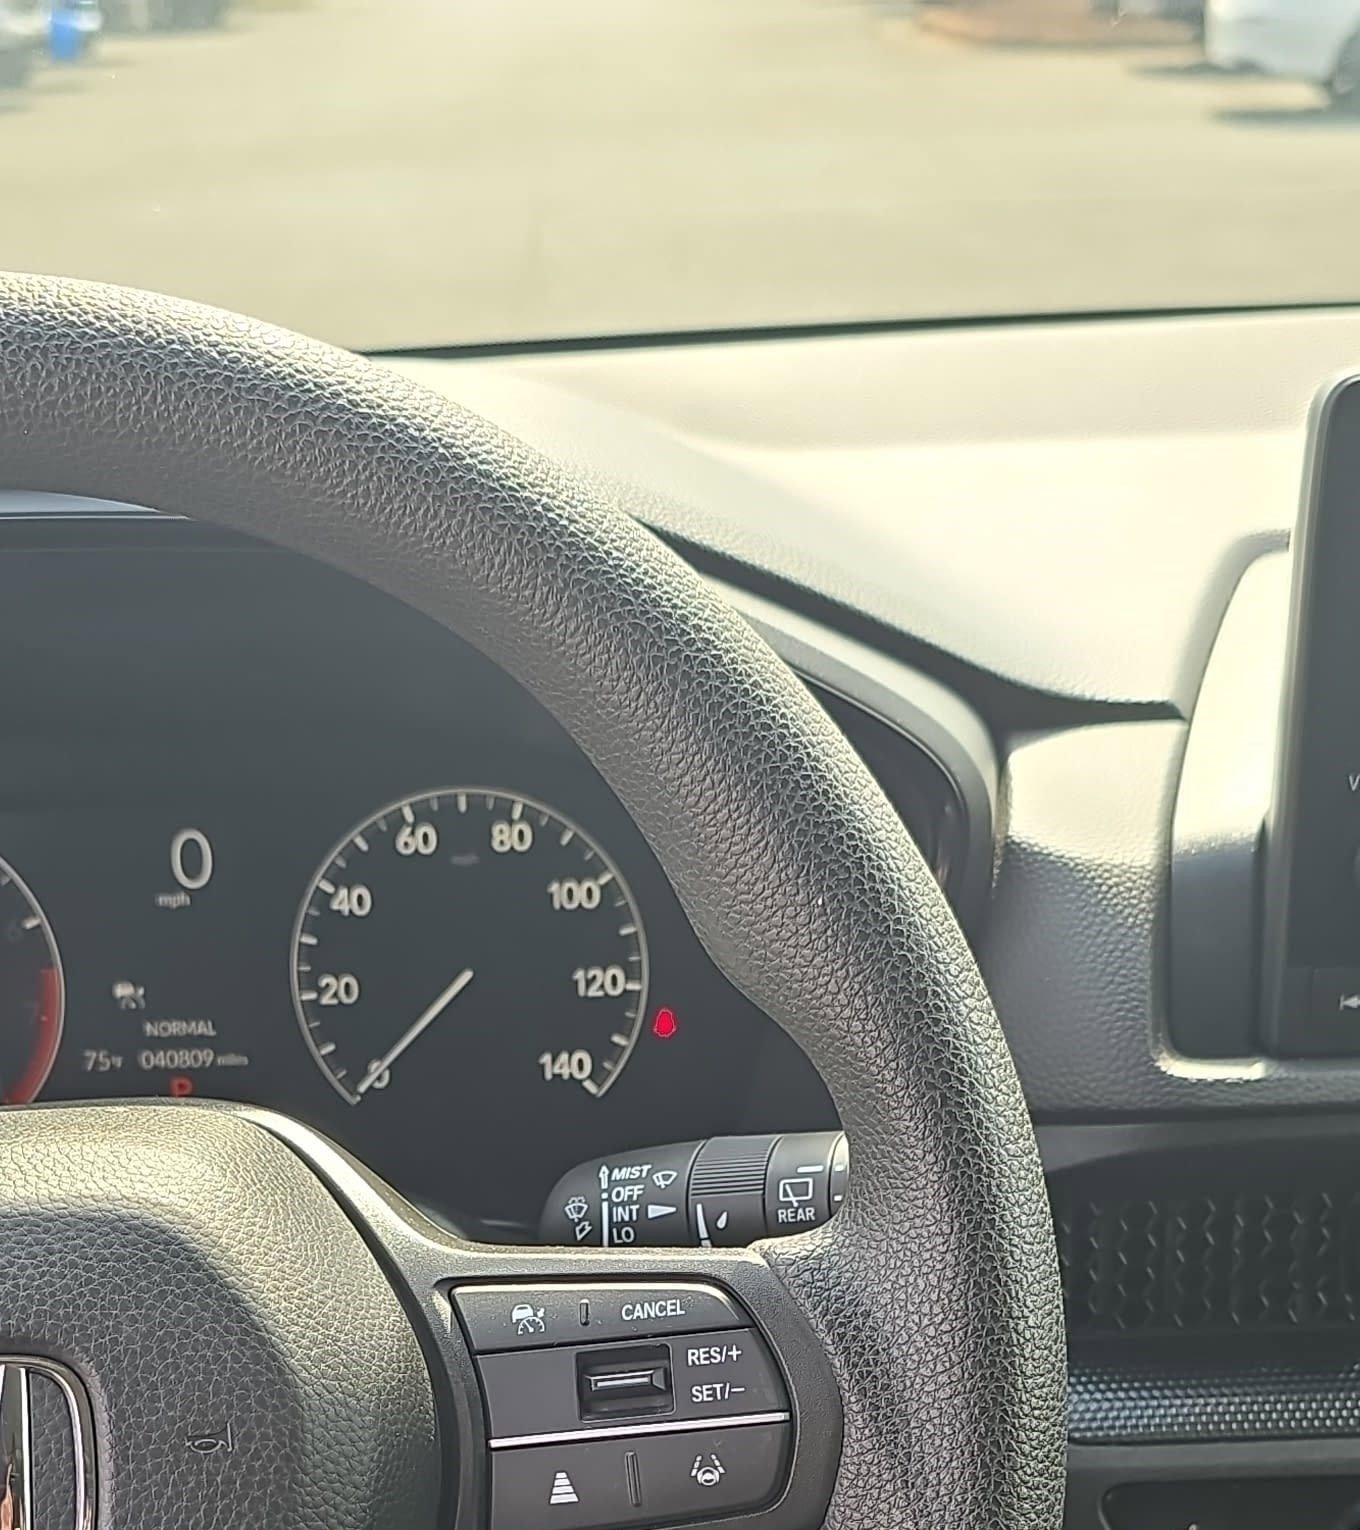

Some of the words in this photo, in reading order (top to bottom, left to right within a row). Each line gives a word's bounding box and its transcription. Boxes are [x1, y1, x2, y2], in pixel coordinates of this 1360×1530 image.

[395, 822, 437, 856] 60
[491, 821, 533, 852] 80
[170, 828, 214, 889] 0
[156, 892, 190, 909] mph
[330, 883, 373, 917] 40
[547, 879, 601, 911] 100
[317, 973, 359, 1006] 20
[572, 965, 626, 997] 120
[144, 1019, 216, 1037] NORMAL
[140, 1048, 215, 1070] 040809
[539, 1049, 593, 1083] 140
[170, 1076, 193, 1095] P
[611, 1164, 652, 1181] MIST
[612, 1185, 643, 1201] OFF
[613, 1205, 640, 1222] INT
[777, 1207, 816, 1225] REAR
[613, 1227, 634, 1244] LO
[621, 1299, 686, 1321] CANCEL
